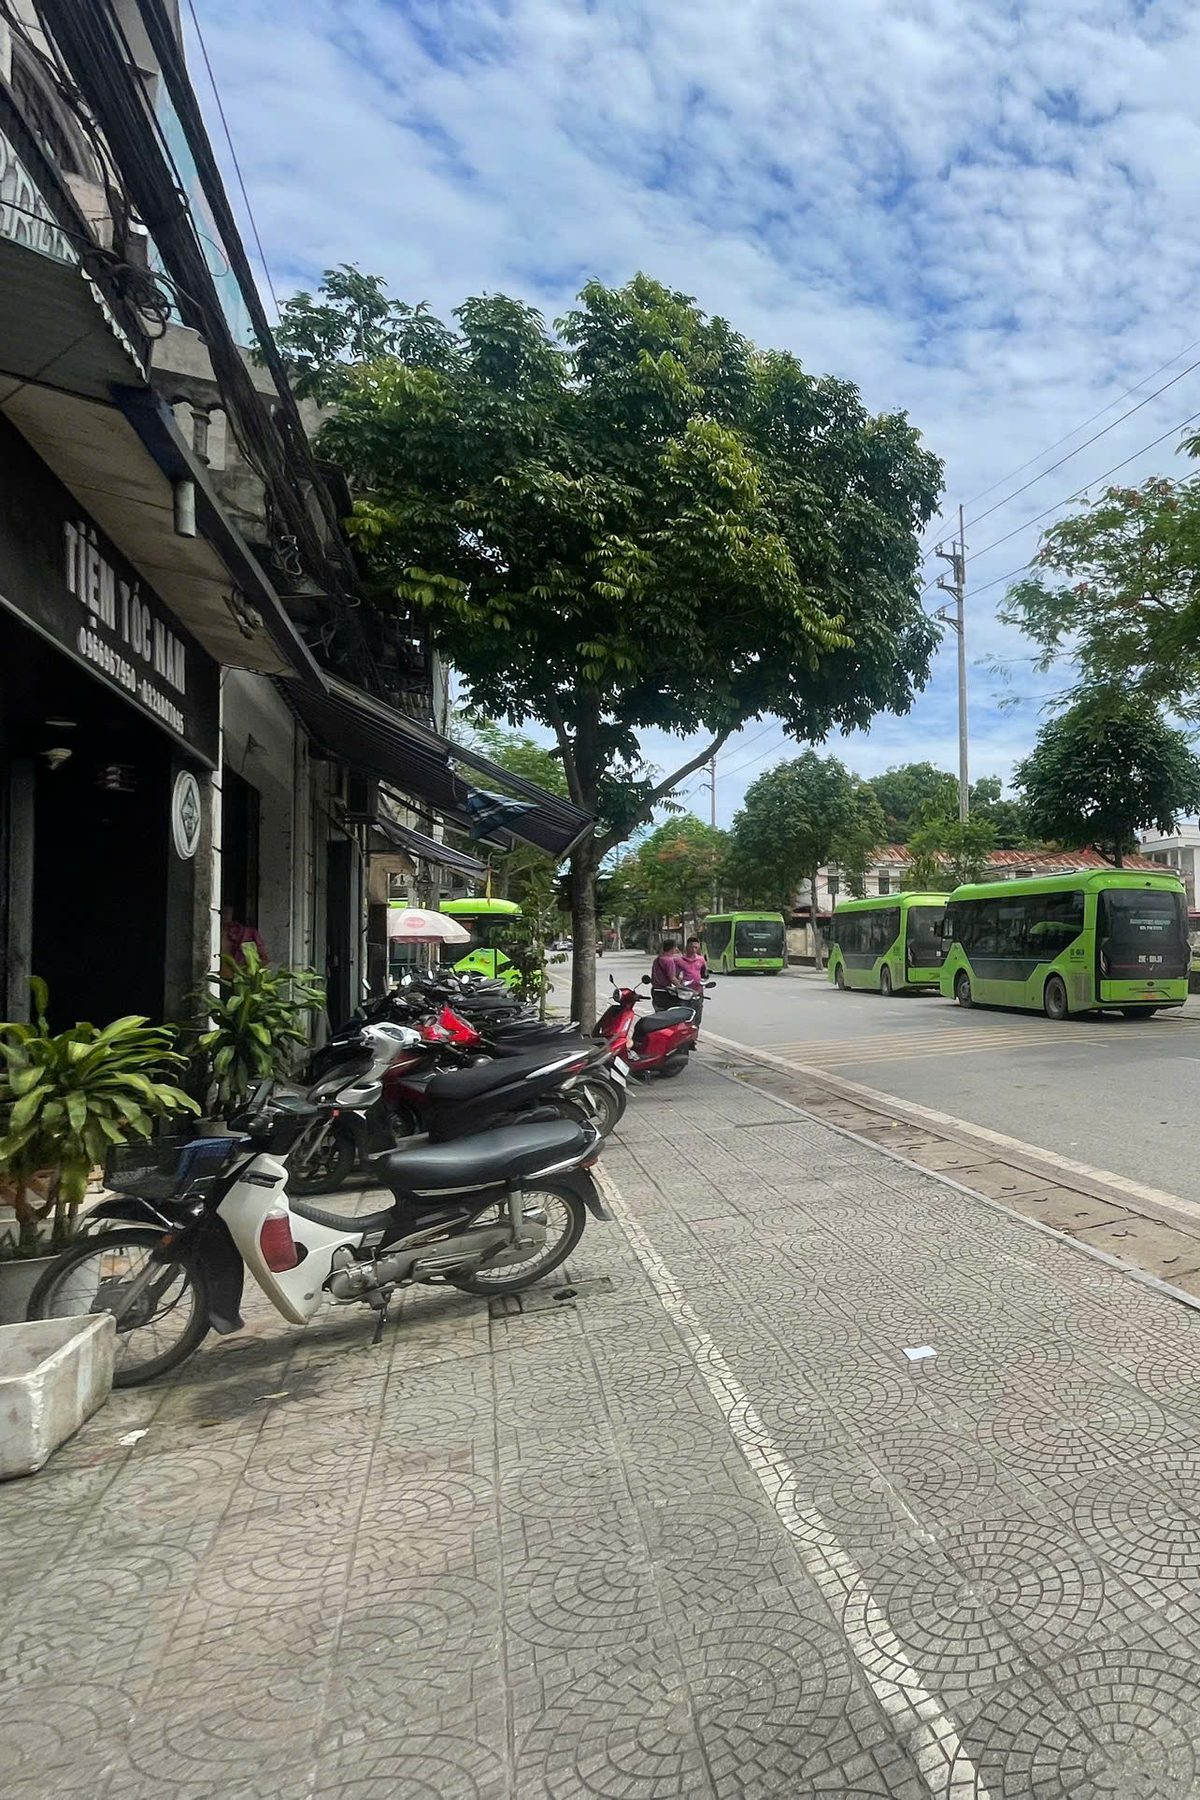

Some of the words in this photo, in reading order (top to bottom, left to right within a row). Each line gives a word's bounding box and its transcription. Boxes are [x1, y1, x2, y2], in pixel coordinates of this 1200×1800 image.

[64, 520, 115, 630] TIỆM
[120, 580, 150, 662] TÓC
[154, 617, 185, 695] NAM
